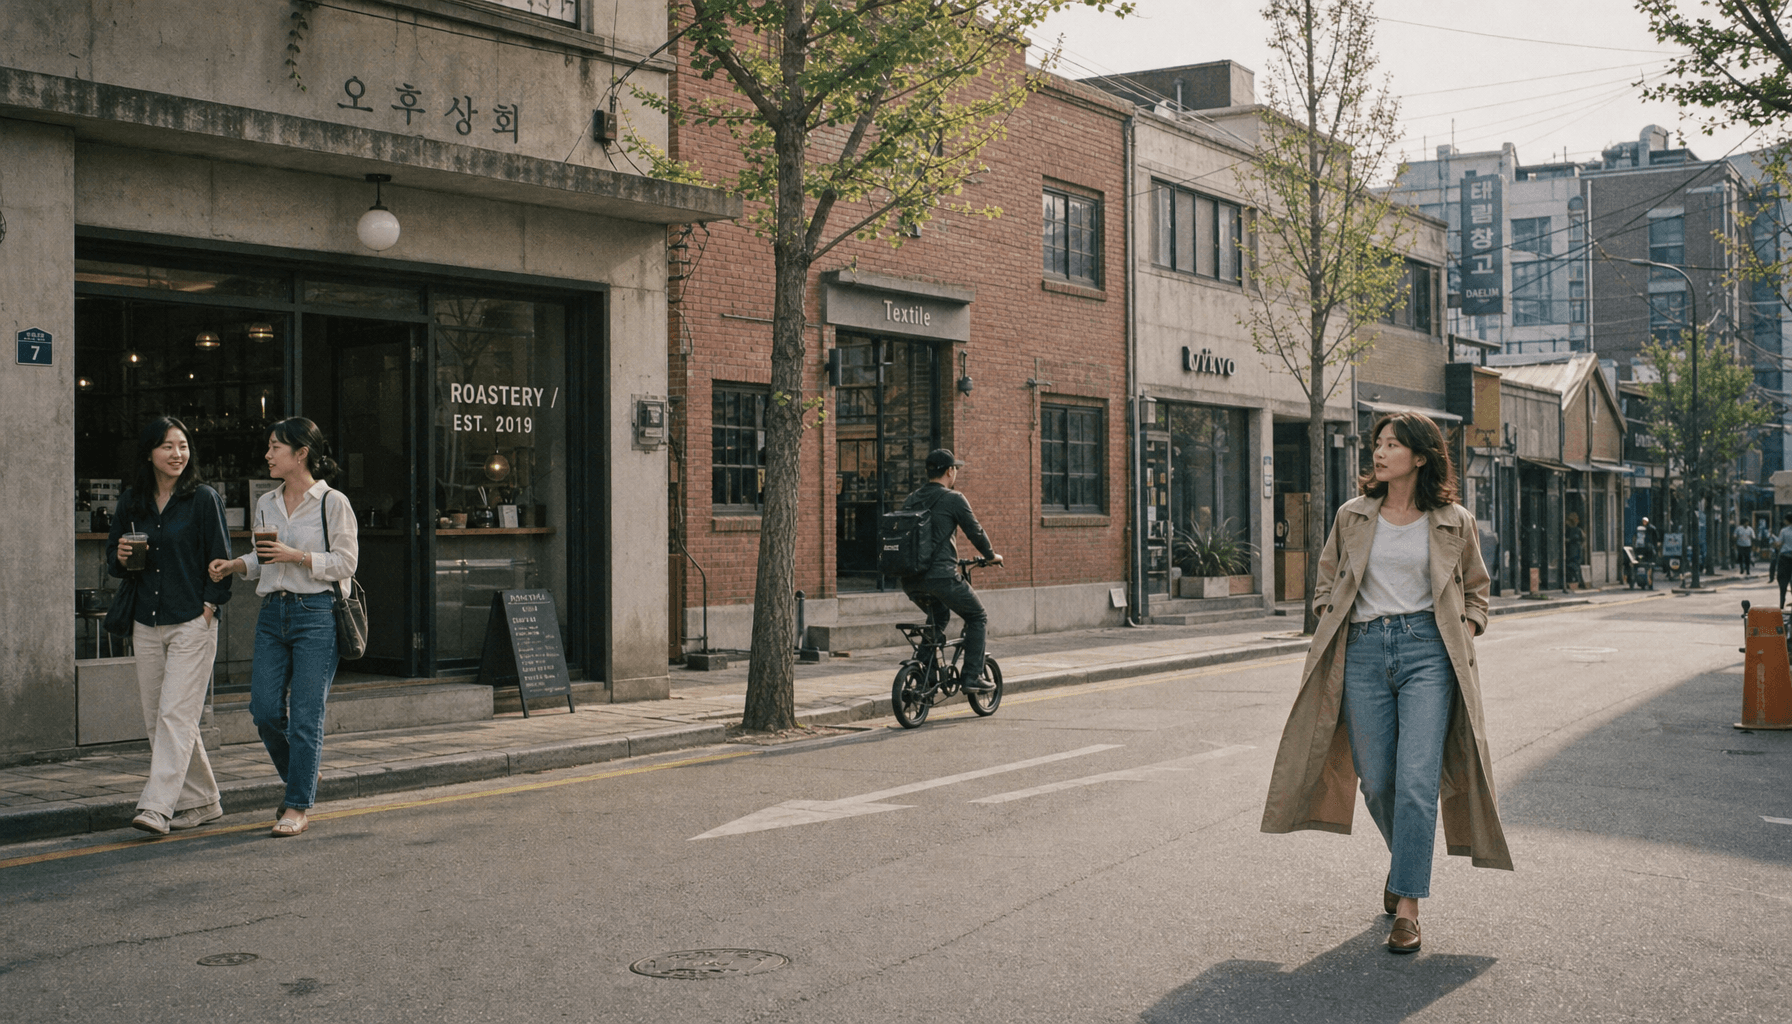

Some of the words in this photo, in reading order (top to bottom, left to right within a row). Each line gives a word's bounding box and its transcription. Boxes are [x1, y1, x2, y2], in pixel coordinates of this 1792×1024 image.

[337, 76, 518, 144] 오후상회
[1466, 287, 1499, 299] DAELIM
[882, 299, 931, 326] Textile
[31, 345, 40, 361] 7
[450, 382, 544, 407] ROASTERY
[453, 413, 488, 432] EST.
[495, 415, 532, 434] 2019
